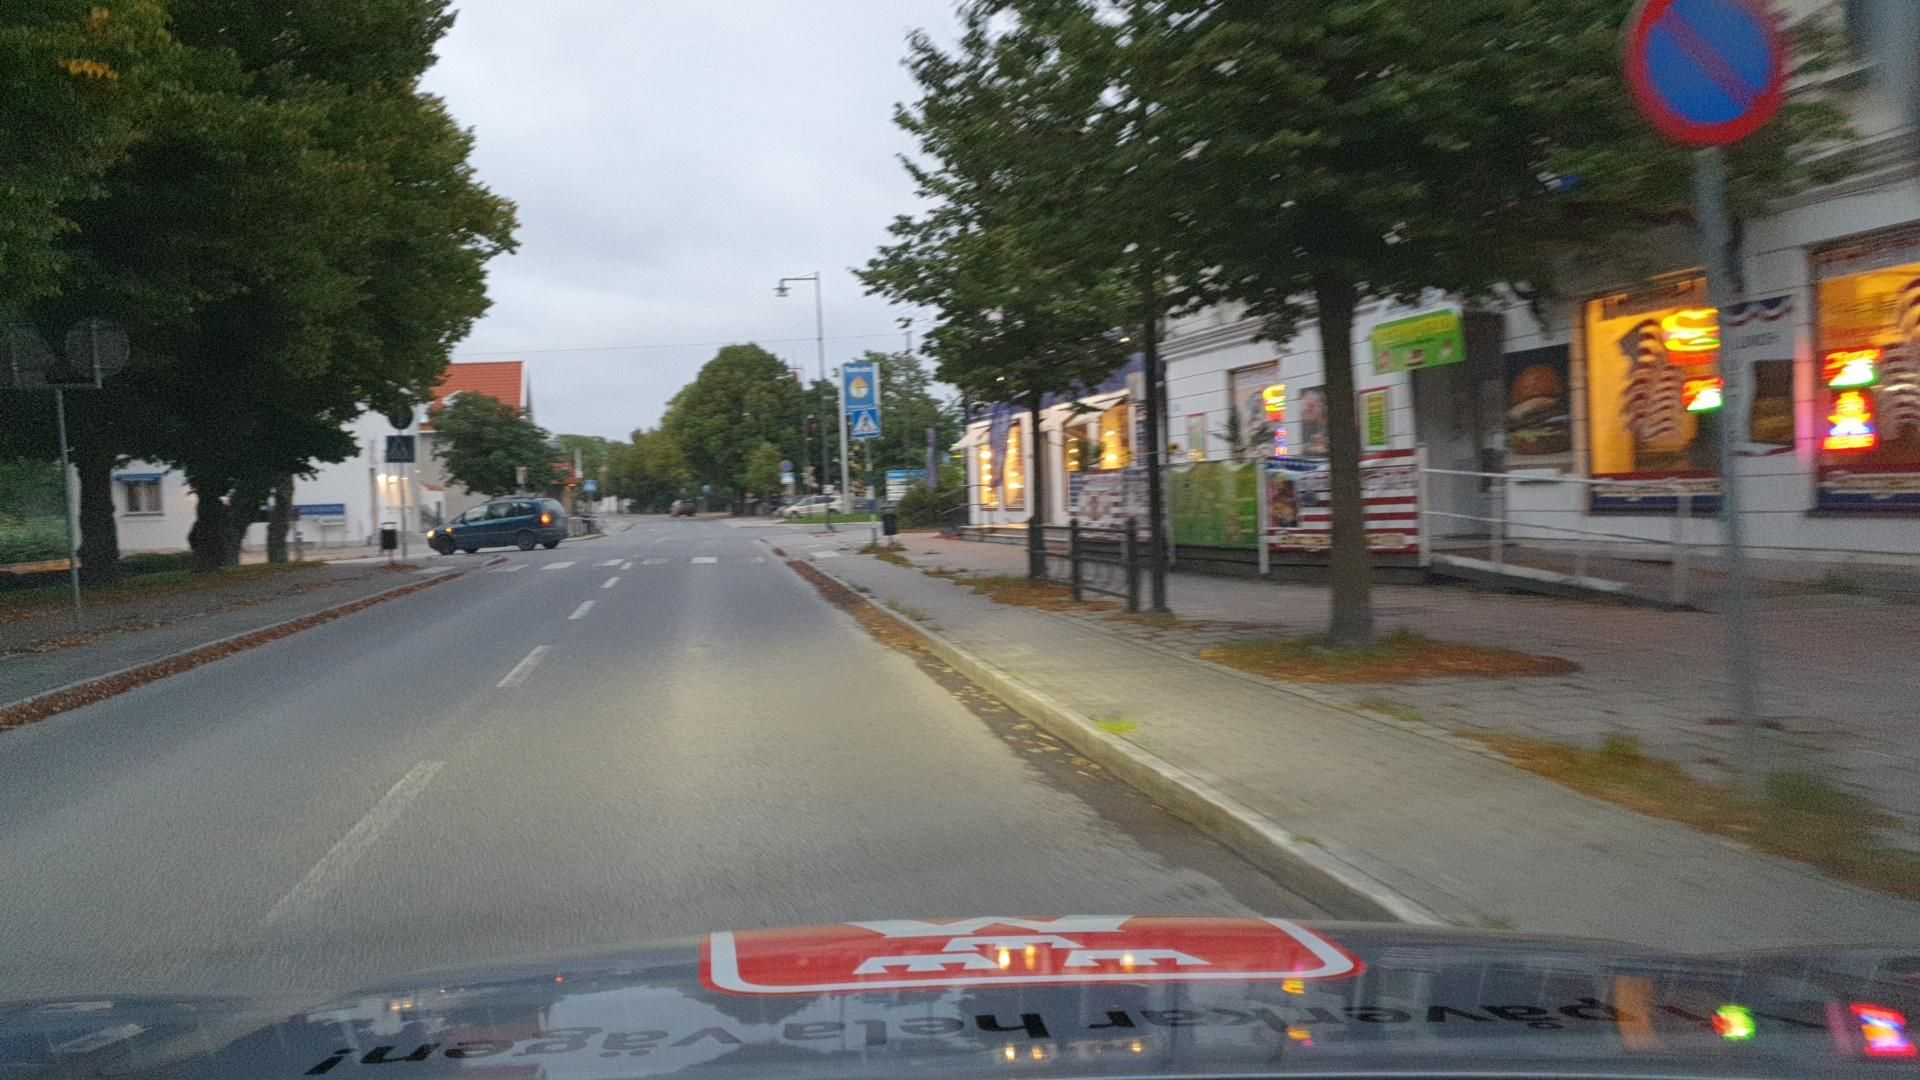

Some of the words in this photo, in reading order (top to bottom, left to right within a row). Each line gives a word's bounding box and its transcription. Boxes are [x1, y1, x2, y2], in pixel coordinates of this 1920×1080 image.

[783, 1012, 1051, 1046] hela
[1088, 997, 1637, 1034] påverkar
[303, 1026, 742, 1076] vägen!
